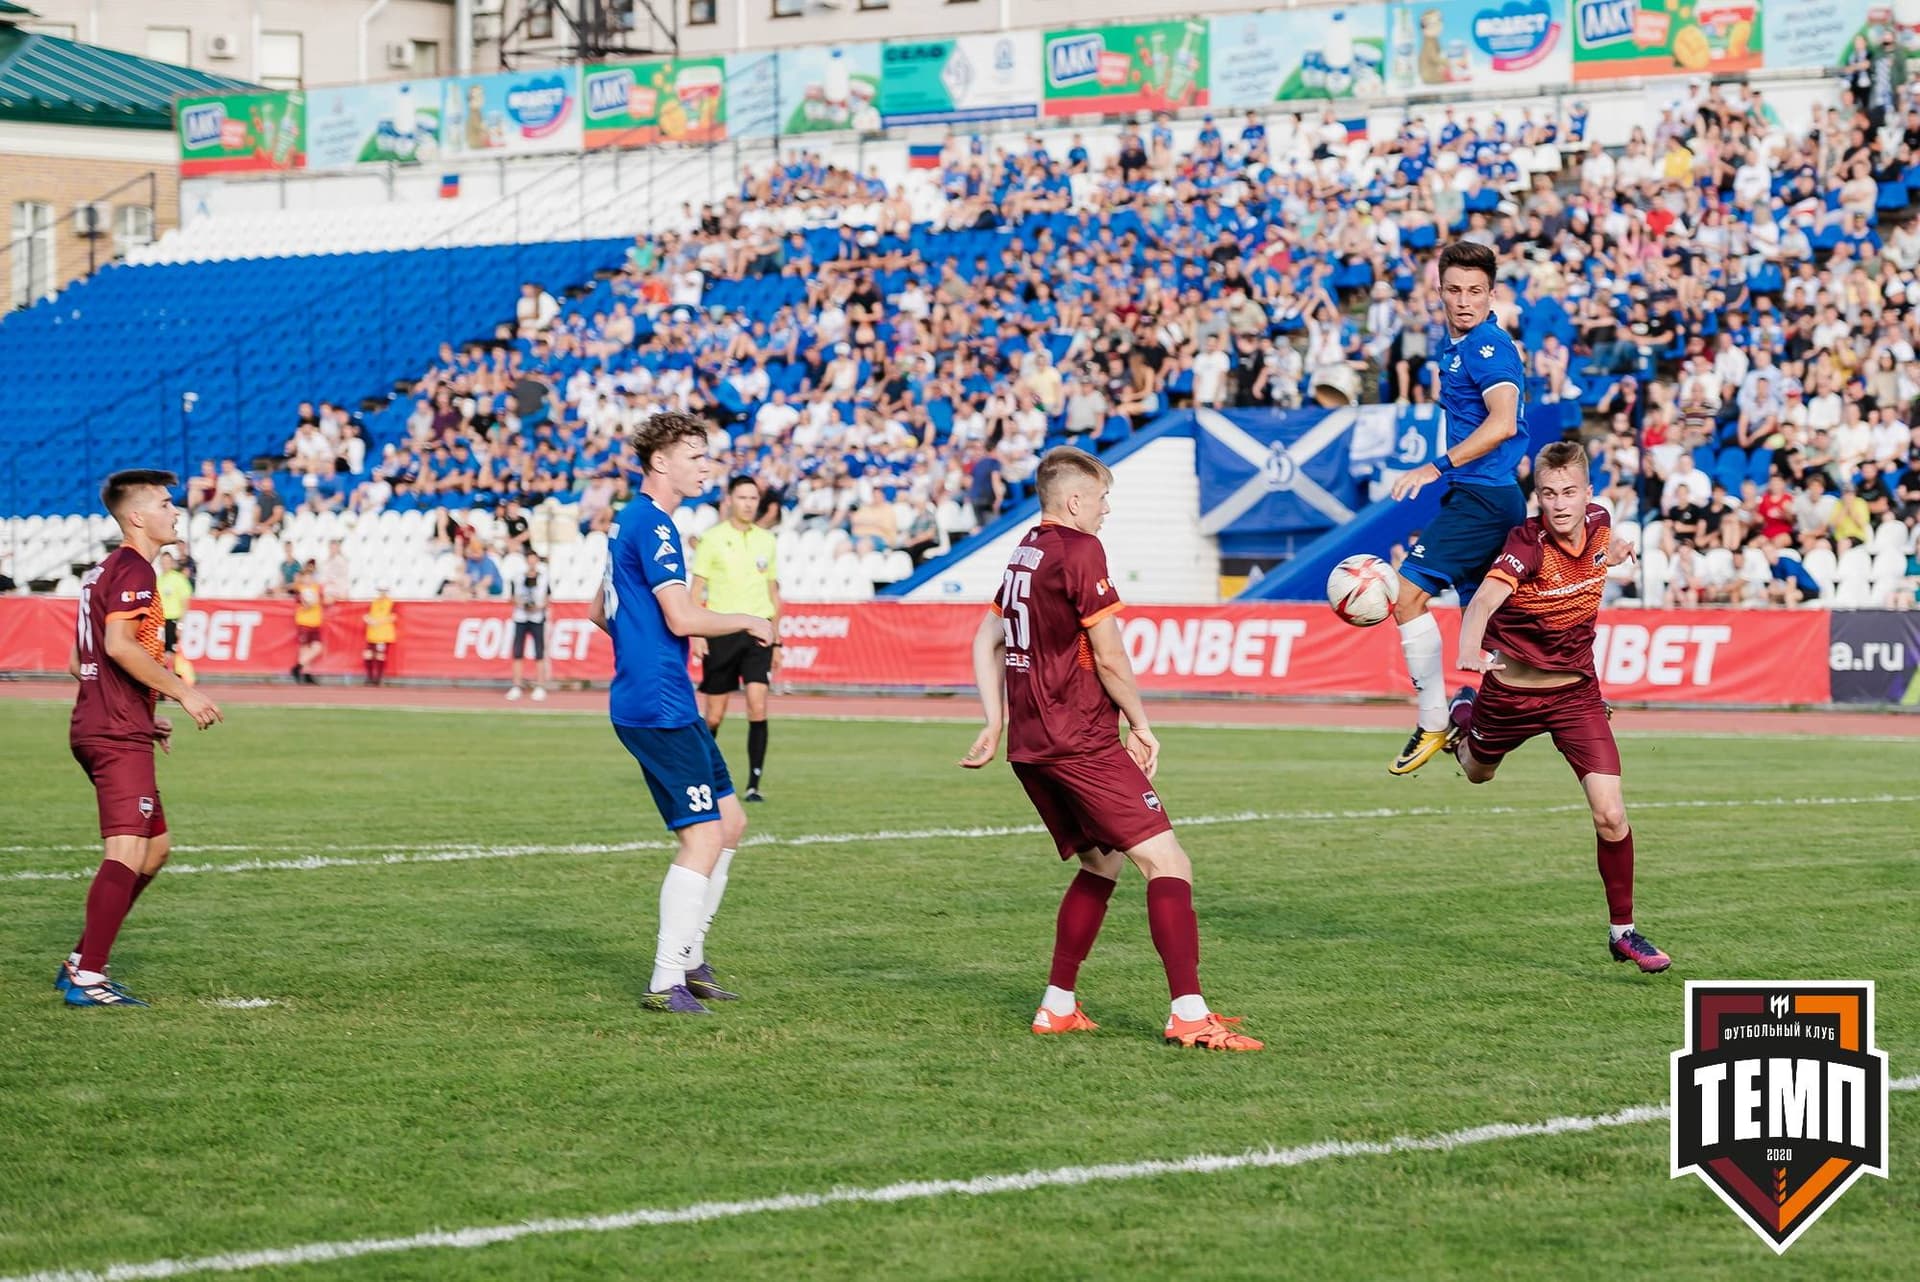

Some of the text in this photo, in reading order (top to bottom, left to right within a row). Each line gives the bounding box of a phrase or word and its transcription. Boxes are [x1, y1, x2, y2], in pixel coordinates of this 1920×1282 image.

[182, 609, 263, 661] BET
[778, 615, 850, 638] ОССИИ
[1002, 569, 1032, 650] 25
[454, 617, 597, 660] FOET
[1115, 617, 1307, 677] ONBET
[1594, 623, 1732, 686] BET
[686, 784, 713, 812] 33
